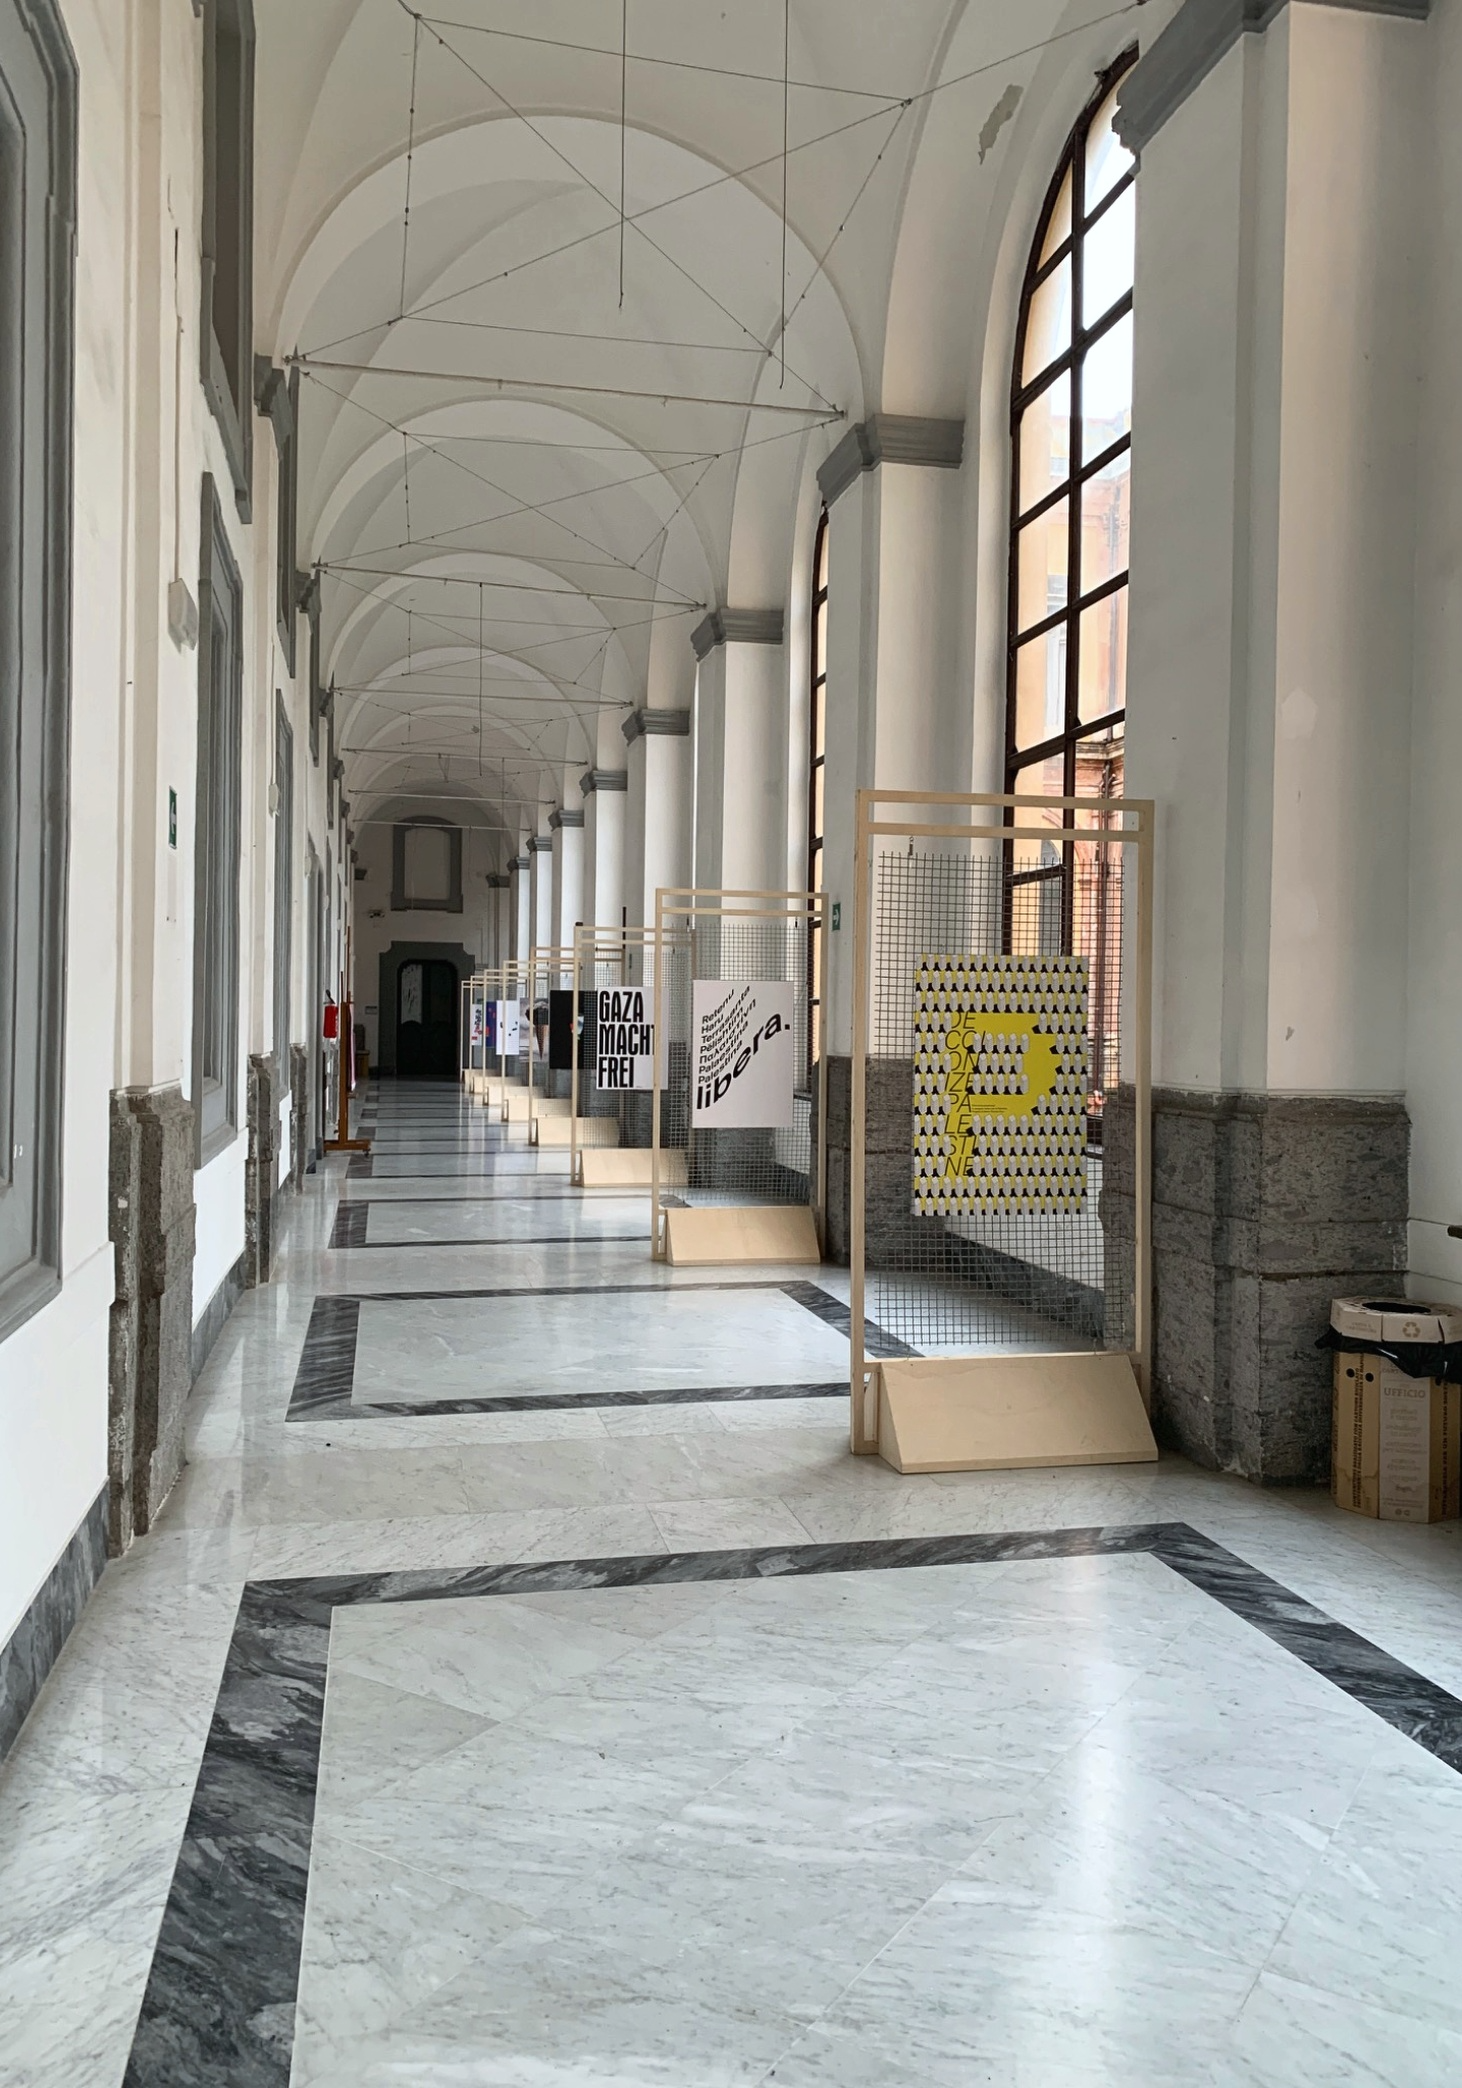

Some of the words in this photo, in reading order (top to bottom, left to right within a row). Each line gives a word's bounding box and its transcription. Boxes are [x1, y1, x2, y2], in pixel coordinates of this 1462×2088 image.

[599, 990, 644, 1023] GAZA
[702, 988, 735, 1025] Retenu
[701, 1013, 724, 1034] Haru
[598, 1056, 635, 1088] FREI
[696, 1013, 790, 1110] libera.
[698, 1040, 743, 1085] Palestina
[944, 1114, 972, 1134] LE
[1384, 1387, 1426, 1398] UFFICIO
